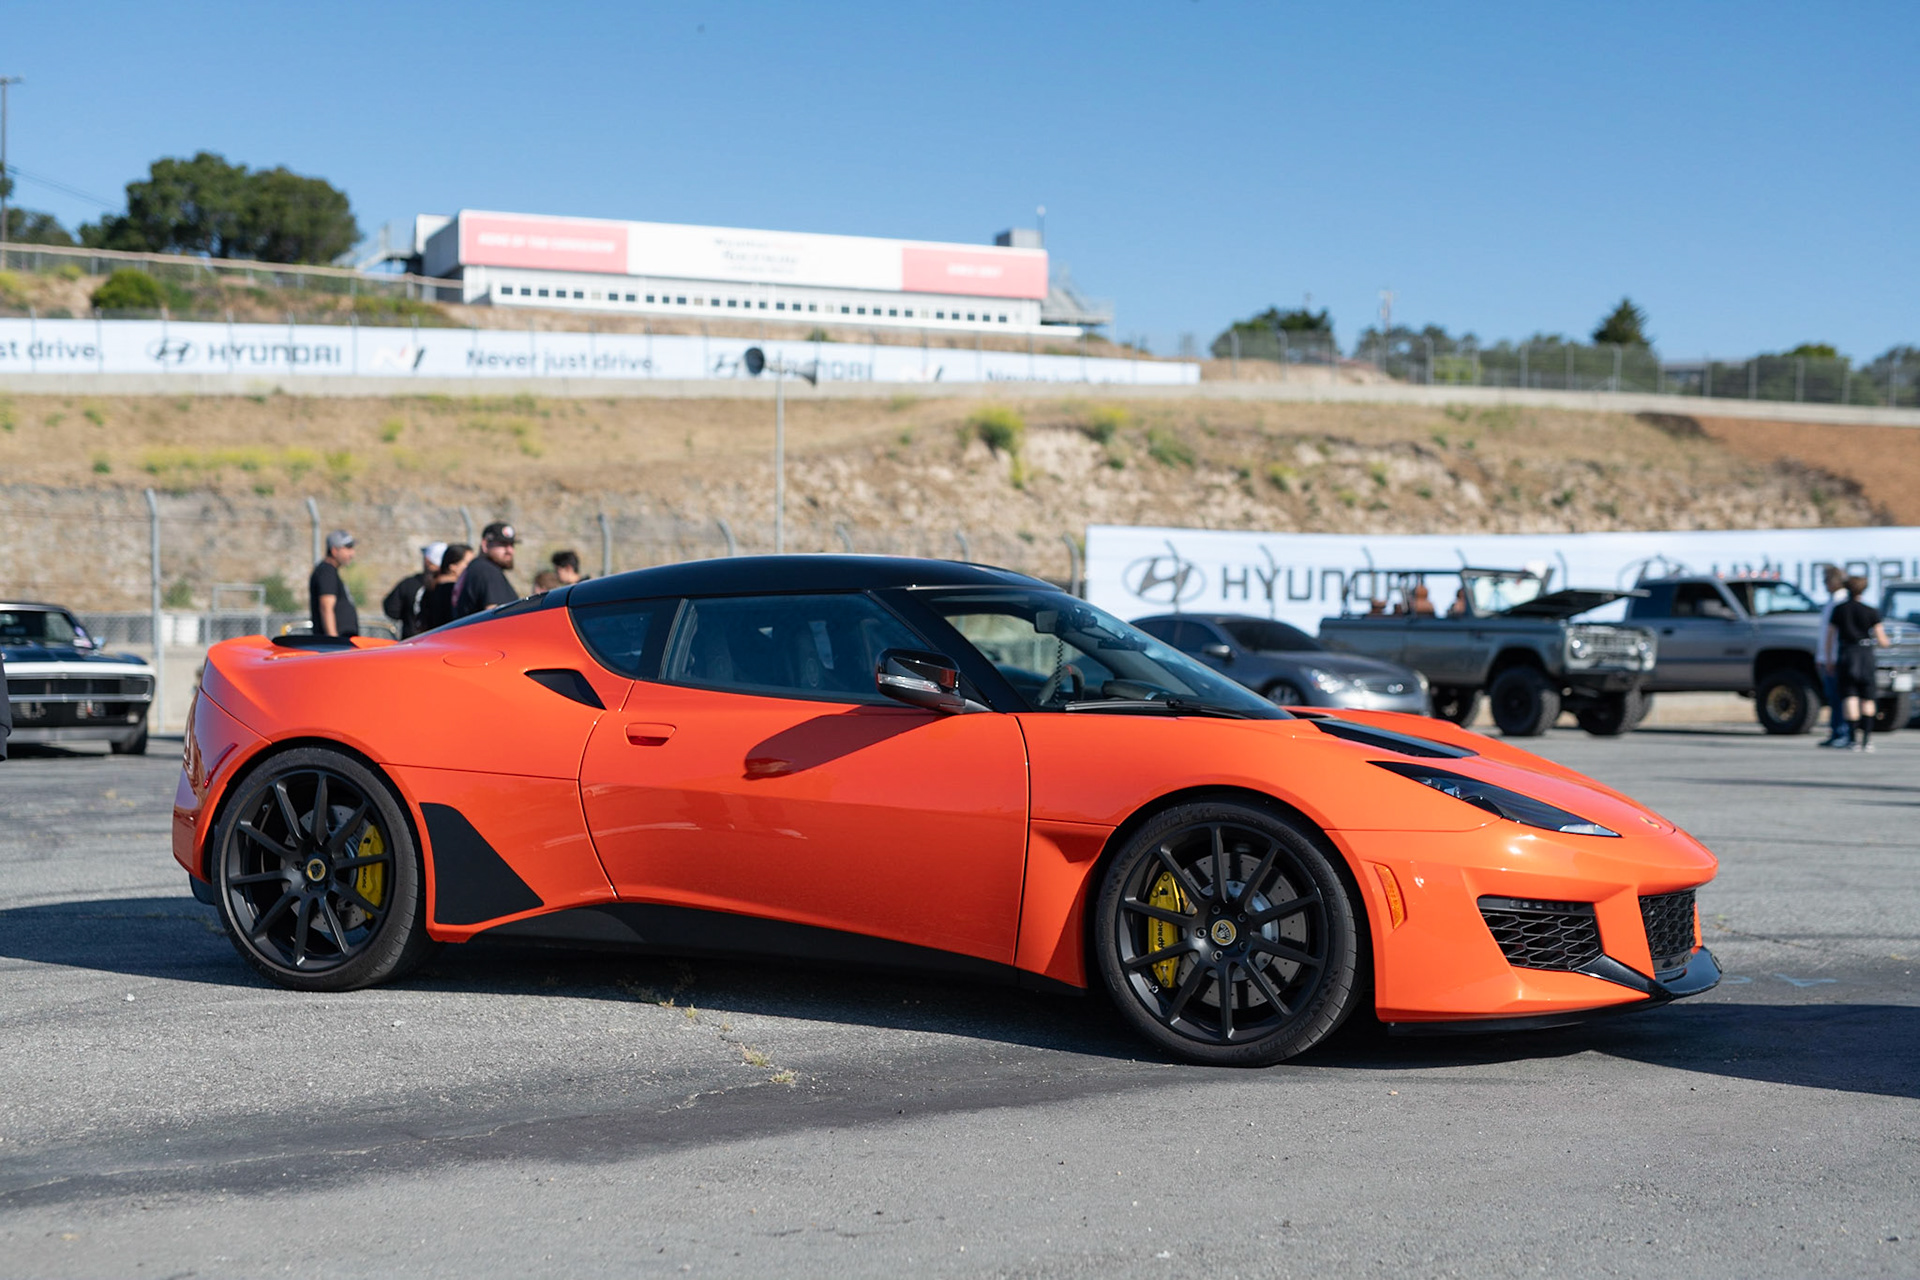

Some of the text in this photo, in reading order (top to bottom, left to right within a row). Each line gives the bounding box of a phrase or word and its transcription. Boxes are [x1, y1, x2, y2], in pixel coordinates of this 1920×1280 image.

[208, 343, 341, 364] HYUNDAI
[465, 349, 538, 370] Never
[543, 350, 589, 373] just
